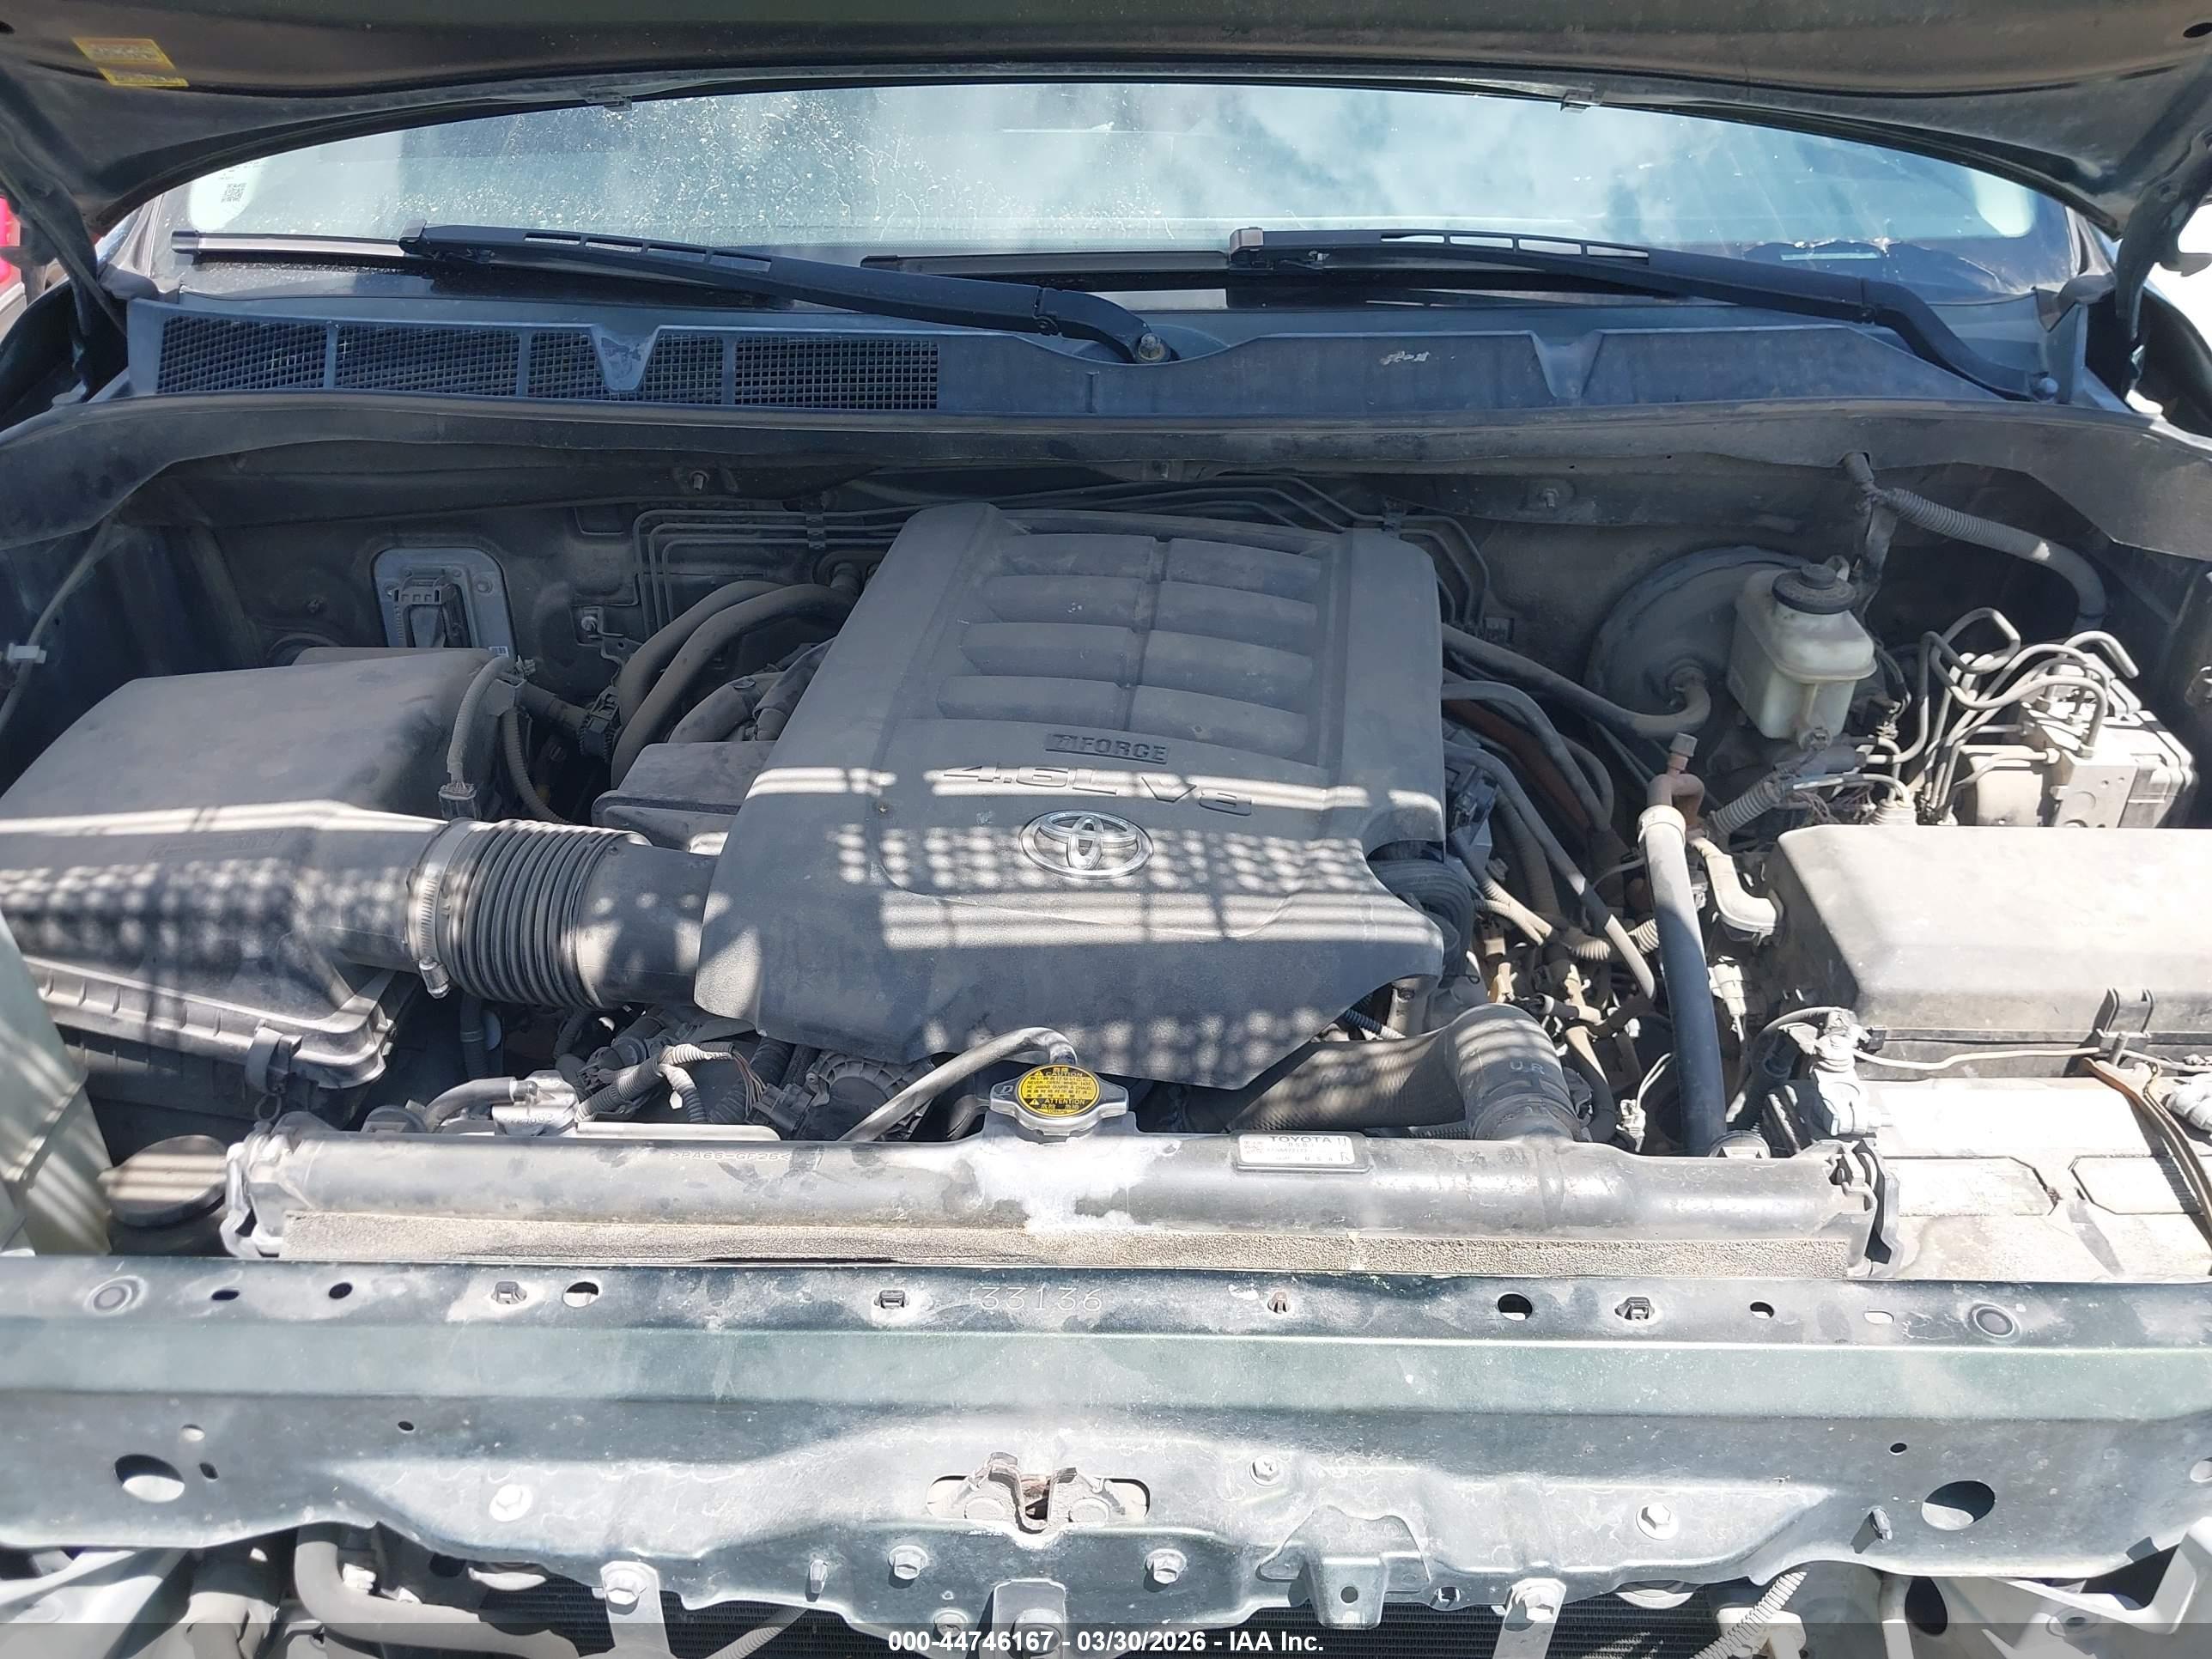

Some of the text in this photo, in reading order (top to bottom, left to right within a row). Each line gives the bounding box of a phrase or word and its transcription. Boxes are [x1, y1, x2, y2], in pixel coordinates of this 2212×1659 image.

[943, 763, 1253, 817] 4.6L V8
[980, 1285, 1103, 1311] 33136
